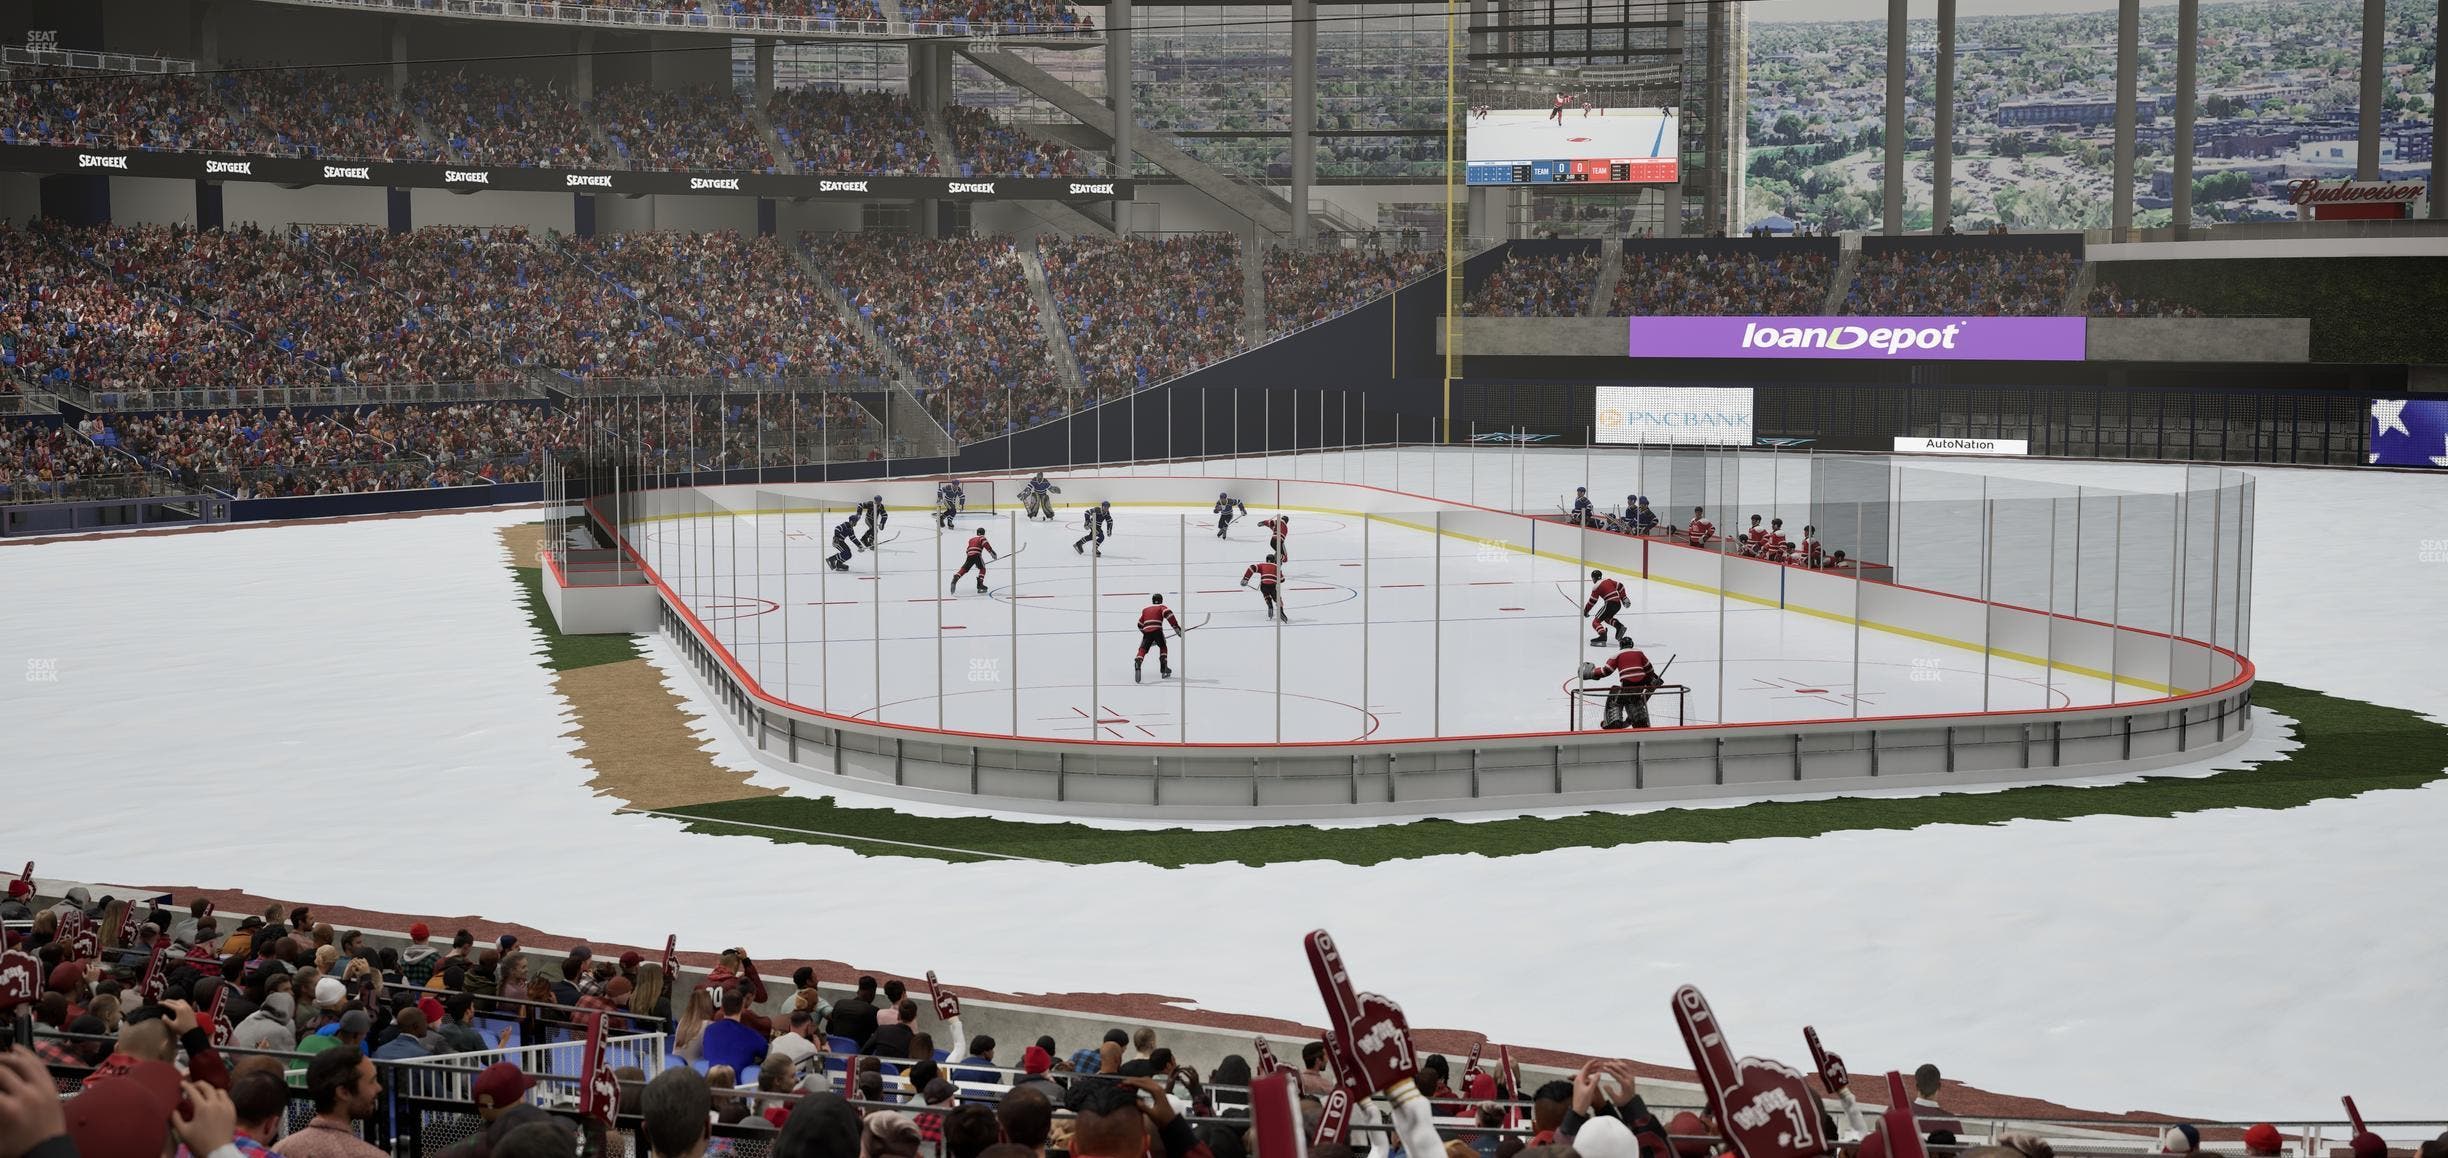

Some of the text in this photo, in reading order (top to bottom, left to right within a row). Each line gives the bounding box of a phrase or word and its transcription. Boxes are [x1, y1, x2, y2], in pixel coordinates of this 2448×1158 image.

[79, 154, 128, 169] SEATGEEK
[206, 160, 252, 175] SEATGEEK
[1559, 163, 1565, 173] 0
[1577, 162, 1583, 173] 0
[323, 165, 370, 180] SEATGEEK
[445, 170, 489, 184] SEATGEEK
[1592, 167, 1607, 175] TEAM
[566, 174, 612, 187] SEATGEEK
[690, 177, 739, 190] SEATGEEK
[819, 180, 868, 193] SEATGEEK
[948, 182, 995, 194] SEATGEEK
[1069, 183, 1114, 195] SEATGEEK
[2288, 179, 2425, 206] Budweiser
[1742, 322, 1961, 355] loanDepot
[1926, 439, 1995, 450] AutoNation
